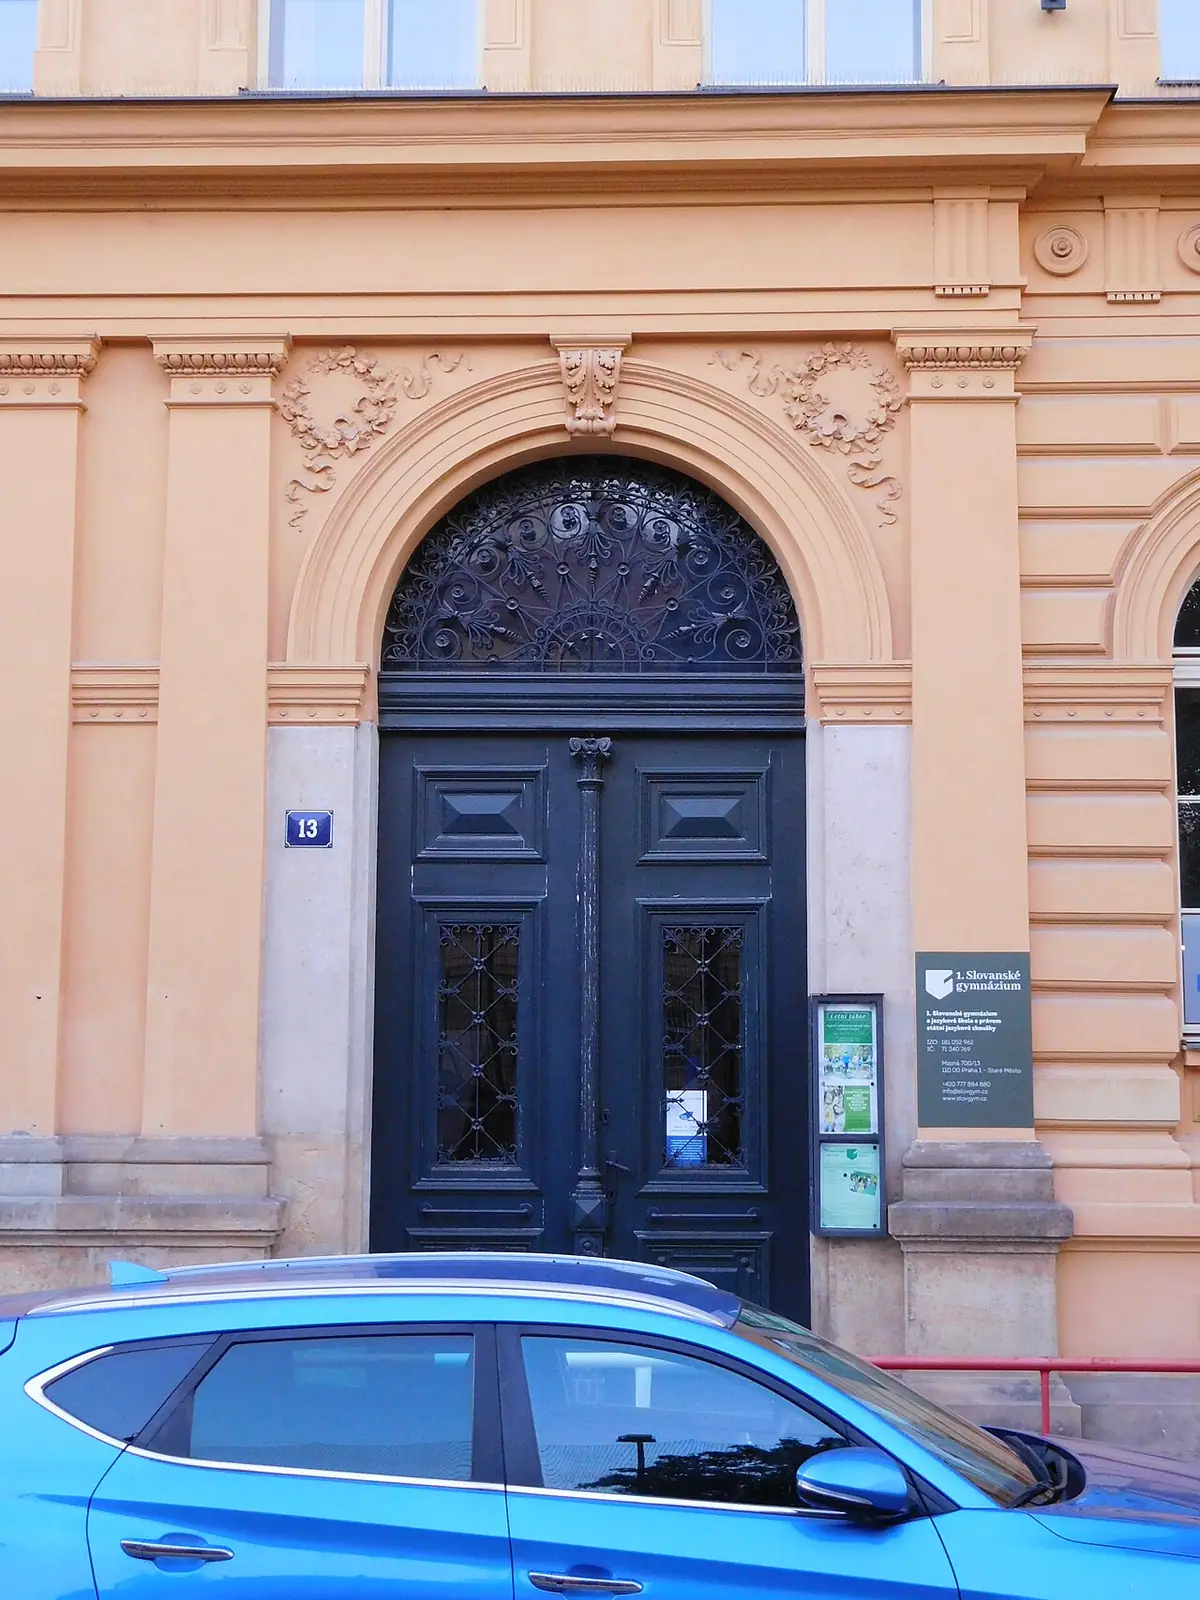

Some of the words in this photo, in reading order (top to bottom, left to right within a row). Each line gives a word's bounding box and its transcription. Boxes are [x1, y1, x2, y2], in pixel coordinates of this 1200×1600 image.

[298, 818, 318, 838] 13
[956, 971, 965, 980] 1.
[966, 970, 1021, 980] Slovanské
[956, 981, 1021, 992] gymnázium
[963, 1010, 998, 1018] gymnázium
[931, 1017, 957, 1025] jazyková
[972, 1025, 997, 1033] zkoušky
